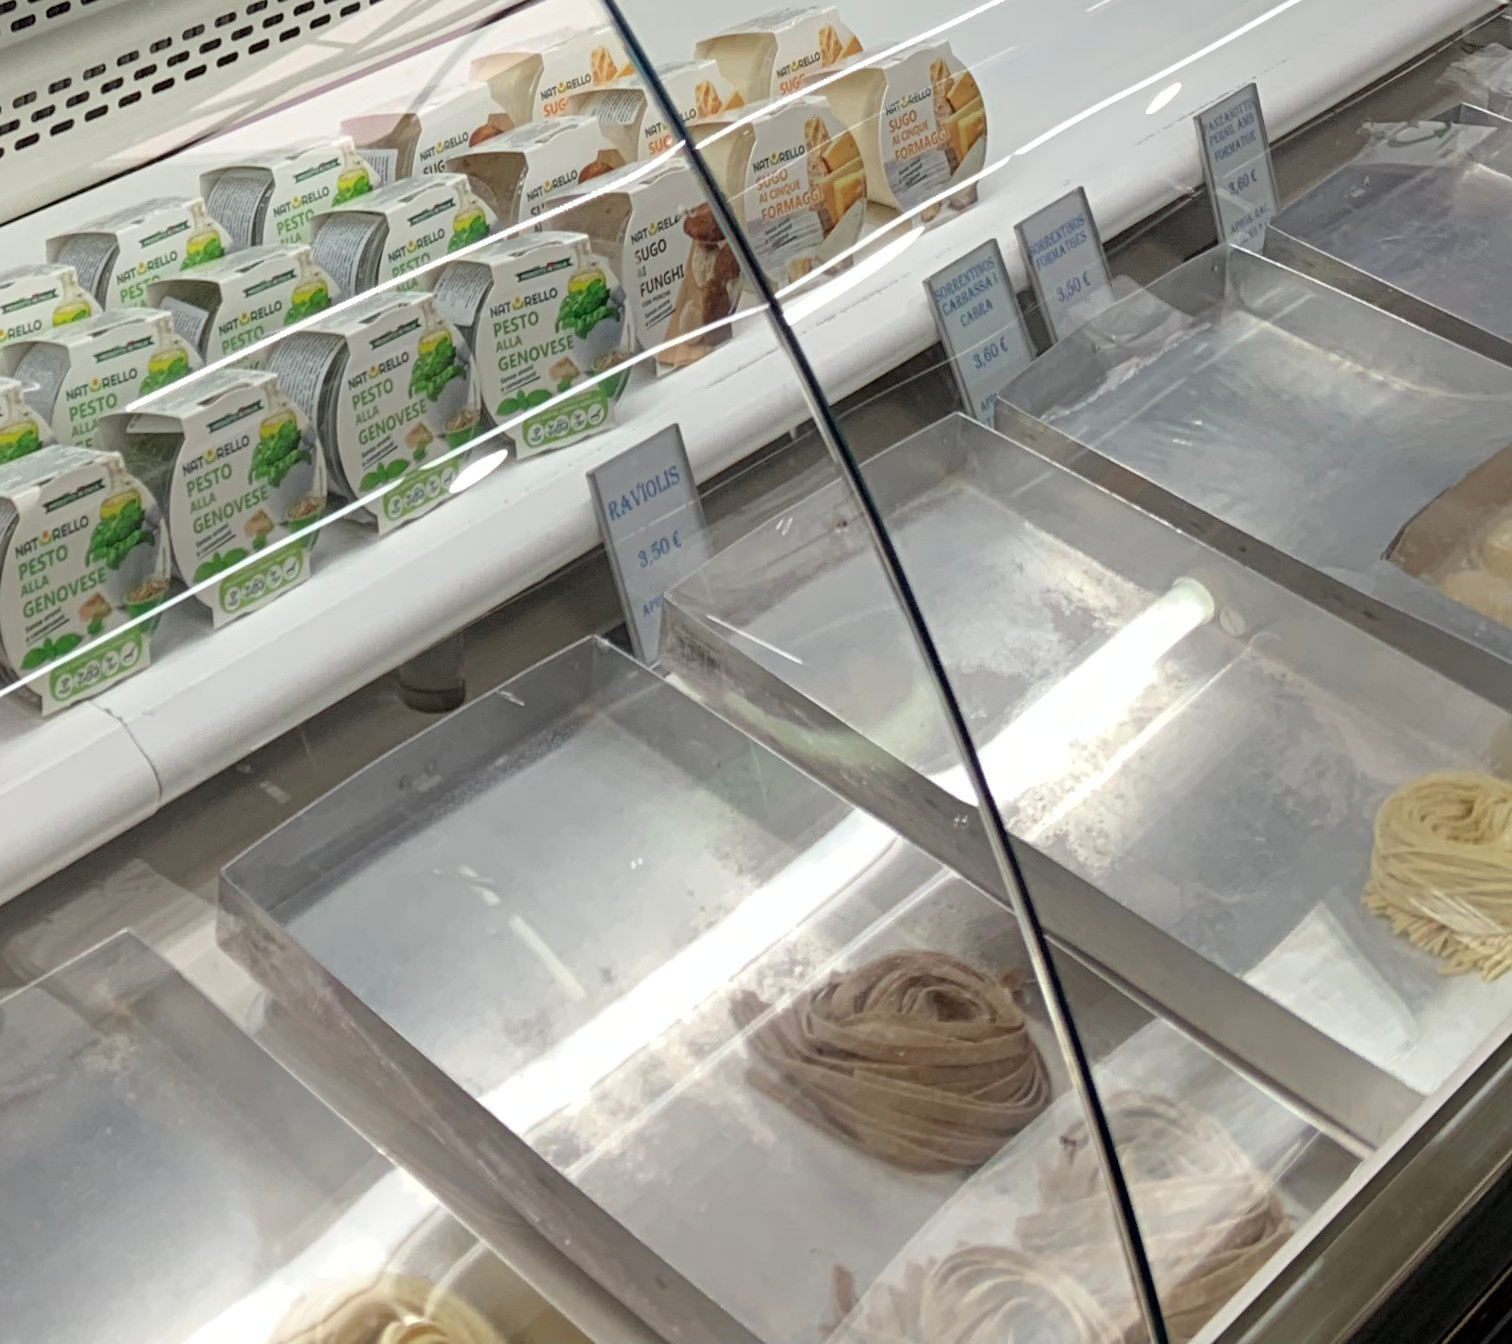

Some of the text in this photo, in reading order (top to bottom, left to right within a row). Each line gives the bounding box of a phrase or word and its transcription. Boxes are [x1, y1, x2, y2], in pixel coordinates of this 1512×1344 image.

[889, 110, 918, 132] SUGO
[892, 120, 929, 145] AI CINQUE
[895, 127, 949, 161] FORMAGGI
[1214, 130, 1257, 162] FORMATGE
[756, 168, 789, 191] SUGO
[759, 179, 801, 204] AI CINQUE
[761, 187, 825, 222] FORMAGGI
[276, 208, 316, 236] PESTO
[634, 238, 667, 264] SUGO
[1036, 231, 1088, 270] FORMATGES
[640, 264, 685, 298] FUNGHI
[934, 256, 995, 302] SORRENTINOS
[1056, 271, 1091, 303] 3,50 €
[942, 277, 992, 316] CARBASSA
[960, 298, 993, 327] CABRA
[222, 326, 264, 355] PESTO
[493, 311, 539, 338] PESTO
[496, 336, 522, 352] ALLA
[498, 334, 575, 373] GENOVESE
[973, 336, 1008, 370] 3,60 €
[69, 393, 118, 422] PESTO
[352, 378, 394, 410] PESTO
[355, 405, 379, 426] ALLA
[358, 398, 427, 445] GENOVESE
[186, 463, 233, 497] PESTO
[607, 465, 681, 522] RAVIOLIS
[190, 492, 217, 514] ALLA
[193, 485, 269, 535] GENOVESE
[18, 545, 68, 581] PESTO
[638, 530, 682, 569] 3,50 €
[20, 575, 49, 599] ALLA
[22, 567, 107, 619] GENOVESE
